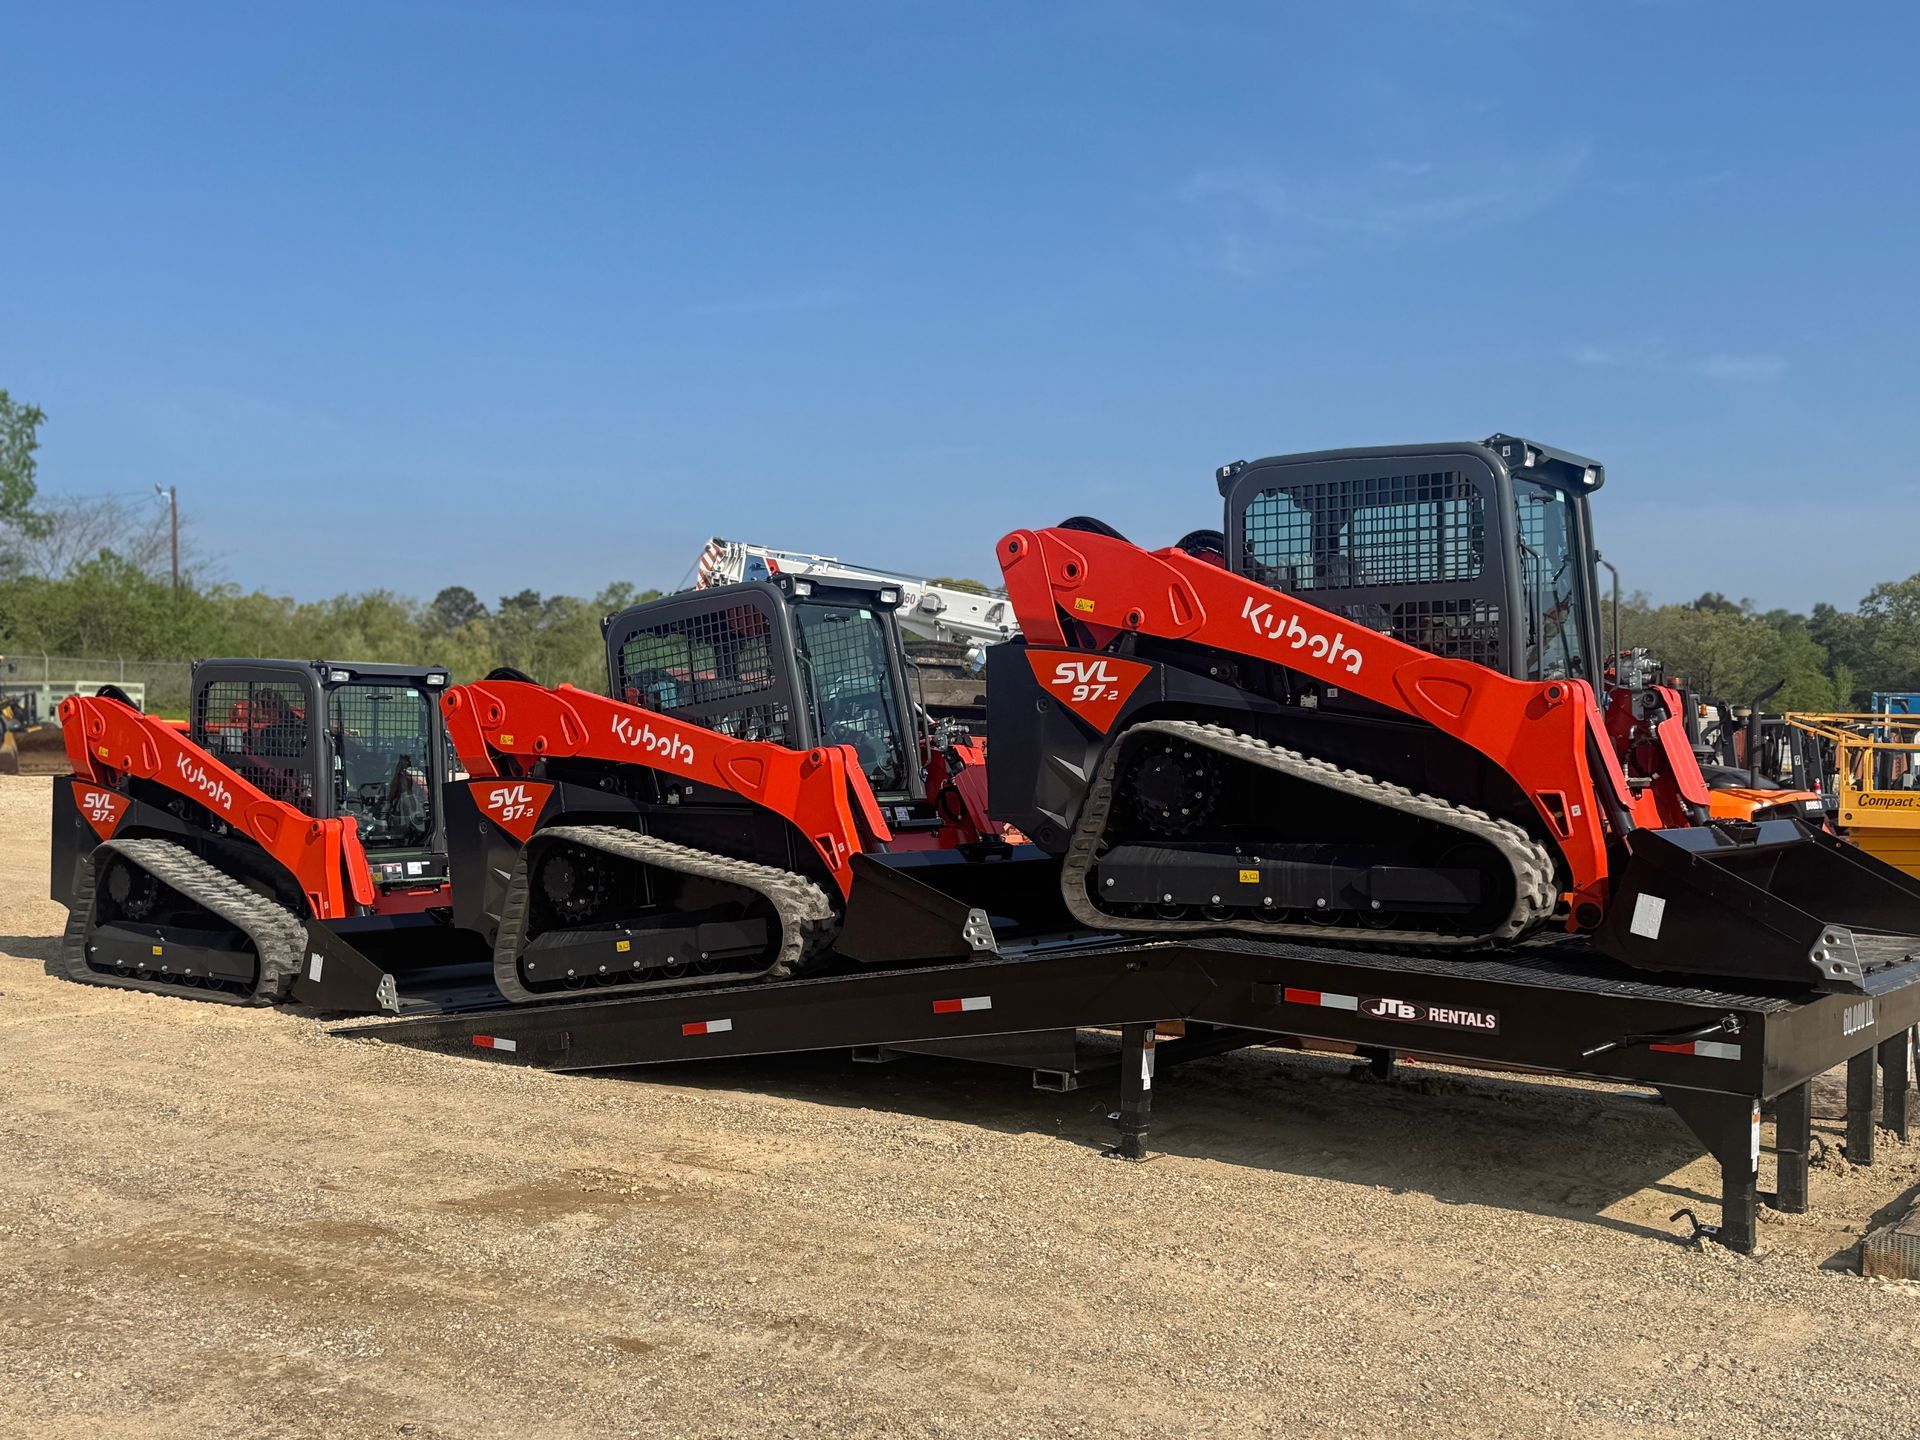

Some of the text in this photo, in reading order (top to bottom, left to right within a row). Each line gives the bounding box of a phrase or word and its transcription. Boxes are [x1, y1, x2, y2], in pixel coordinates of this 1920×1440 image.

[1241, 596, 1363, 675] Kubota
[1051, 661, 1118, 684] SVL
[1071, 684, 1119, 701] 97-2
[611, 714, 694, 765] Kubota
[177, 752, 232, 810] Kubota
[83, 792, 115, 809] SVL
[488, 785, 532, 809] SVL
[1858, 793, 1913, 809] Compact
[91, 809, 115, 822] 97-2
[502, 804, 534, 822] 97-2
[1371, 998, 1496, 1029] JTB RENTALS
